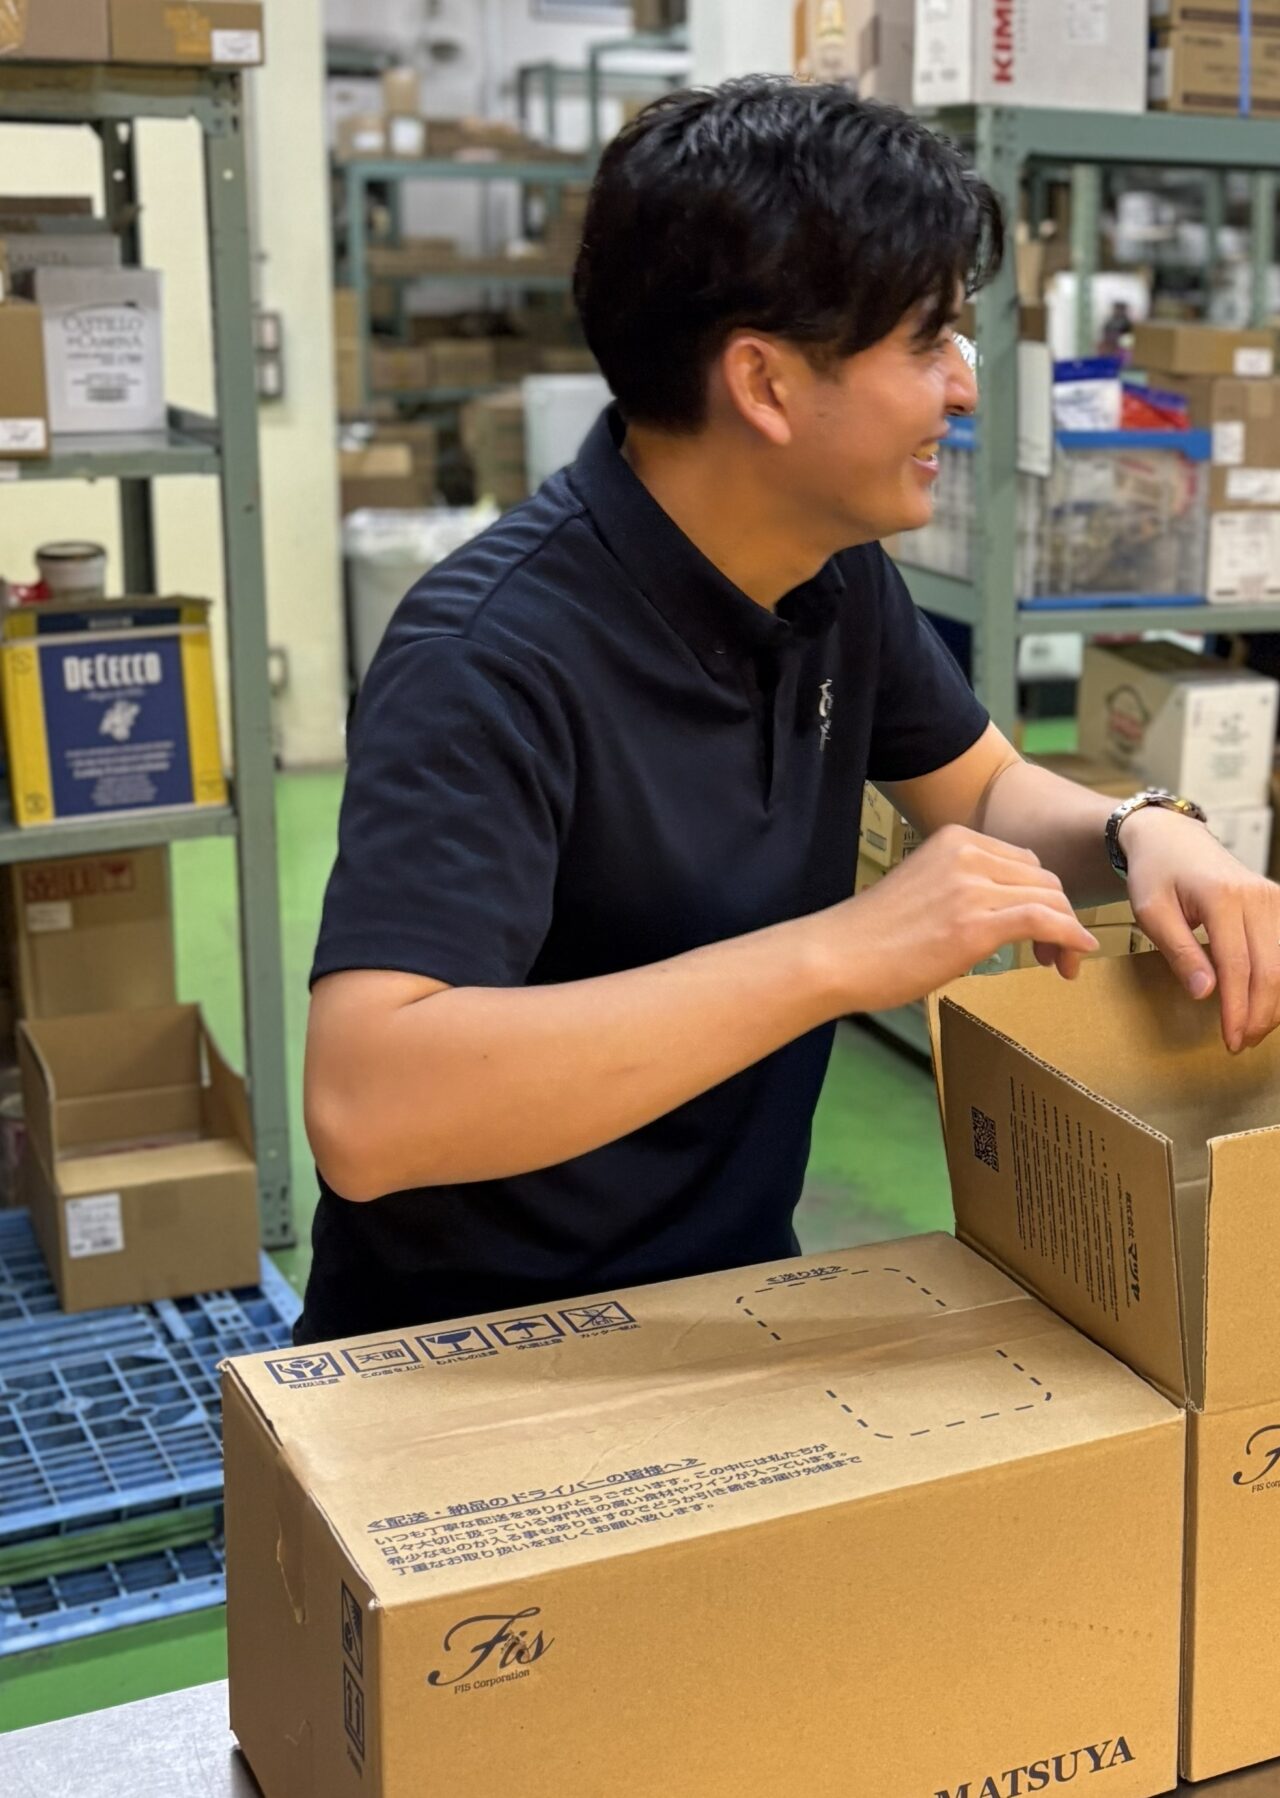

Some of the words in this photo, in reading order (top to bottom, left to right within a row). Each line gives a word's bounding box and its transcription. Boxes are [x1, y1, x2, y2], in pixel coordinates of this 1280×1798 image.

[993, 0, 1013, 82] KIM
[94, 652, 161, 687] CECCO
[355, 1349, 405, 1364] 天面
[427, 1606, 555, 1686] Fis
[454, 1683, 471, 1694] FIS
[474, 1668, 530, 1689] Corporation
